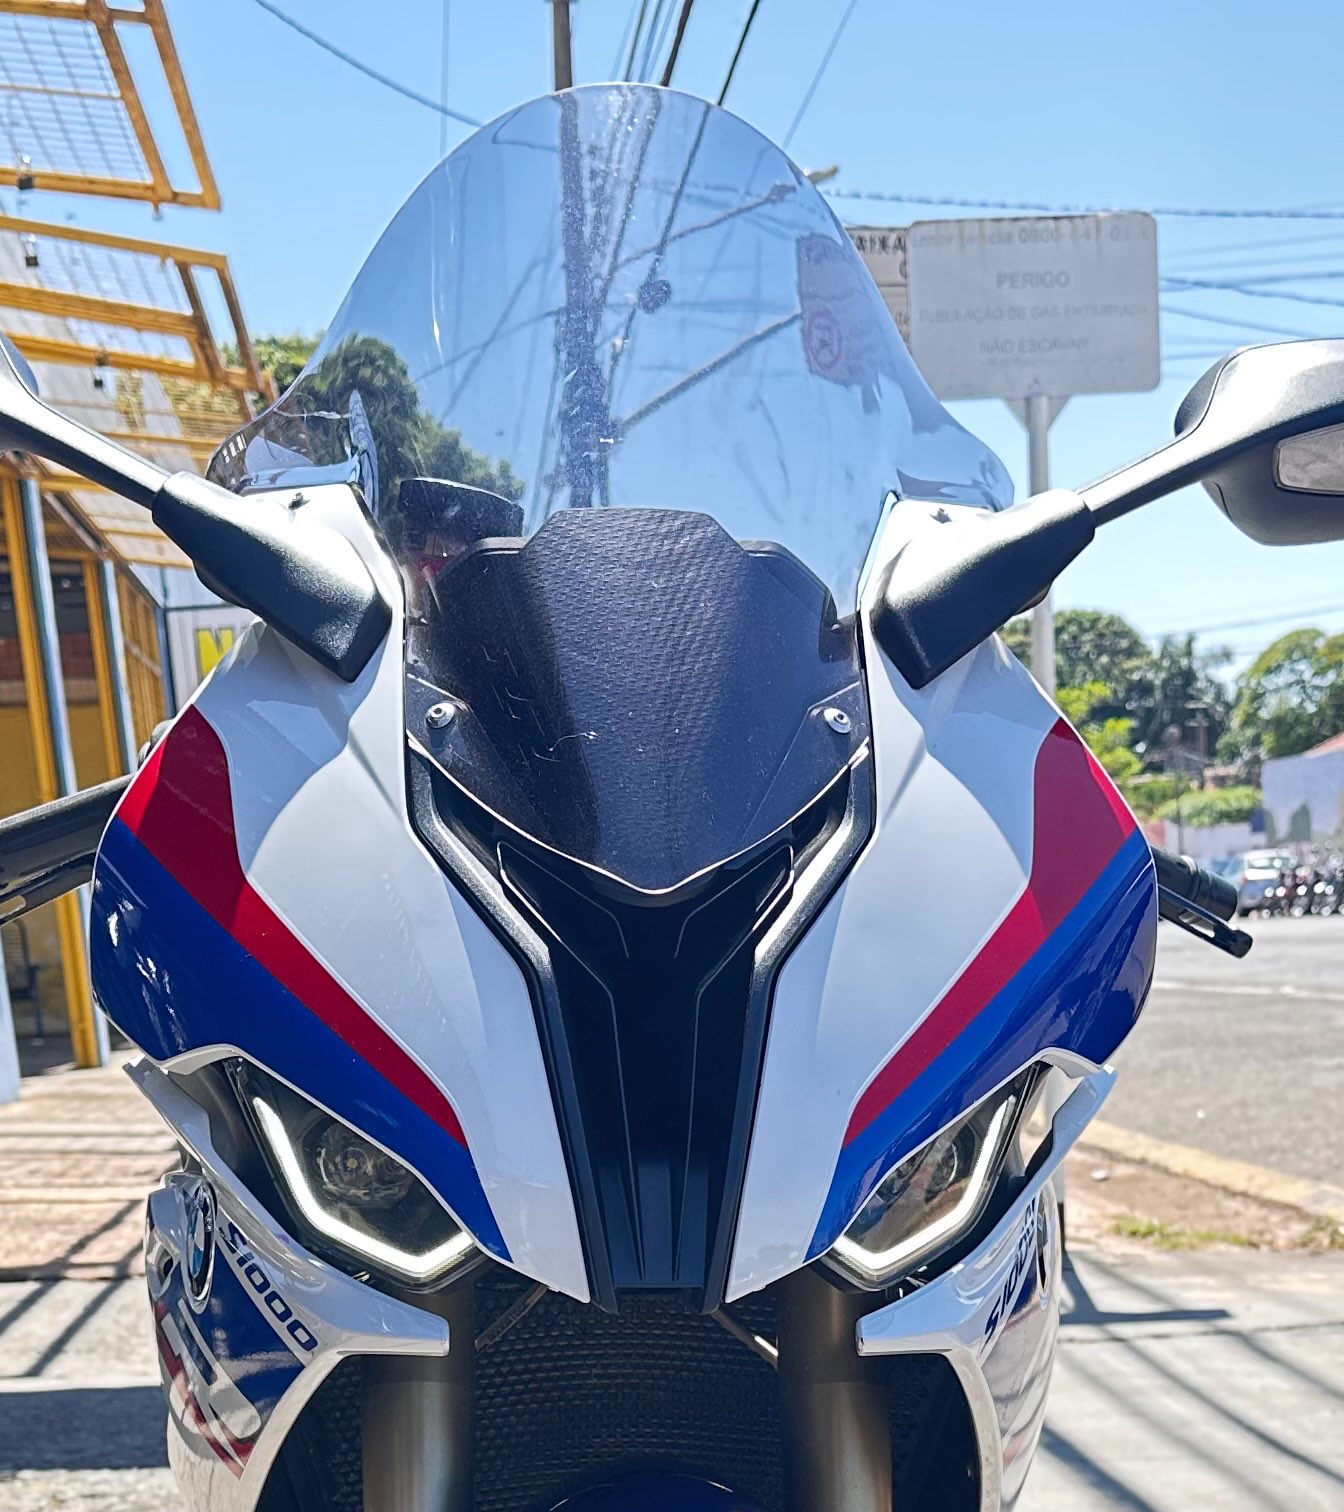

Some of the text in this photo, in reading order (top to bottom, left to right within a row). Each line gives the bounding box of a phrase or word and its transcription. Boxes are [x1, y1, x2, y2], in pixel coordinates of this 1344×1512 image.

[996, 270, 1071, 289] PERIGO
[1007, 305, 1026, 320] DE
[979, 335, 1089, 354] NÃO ESCAVAR
[218, 1221, 319, 1352] S1000
